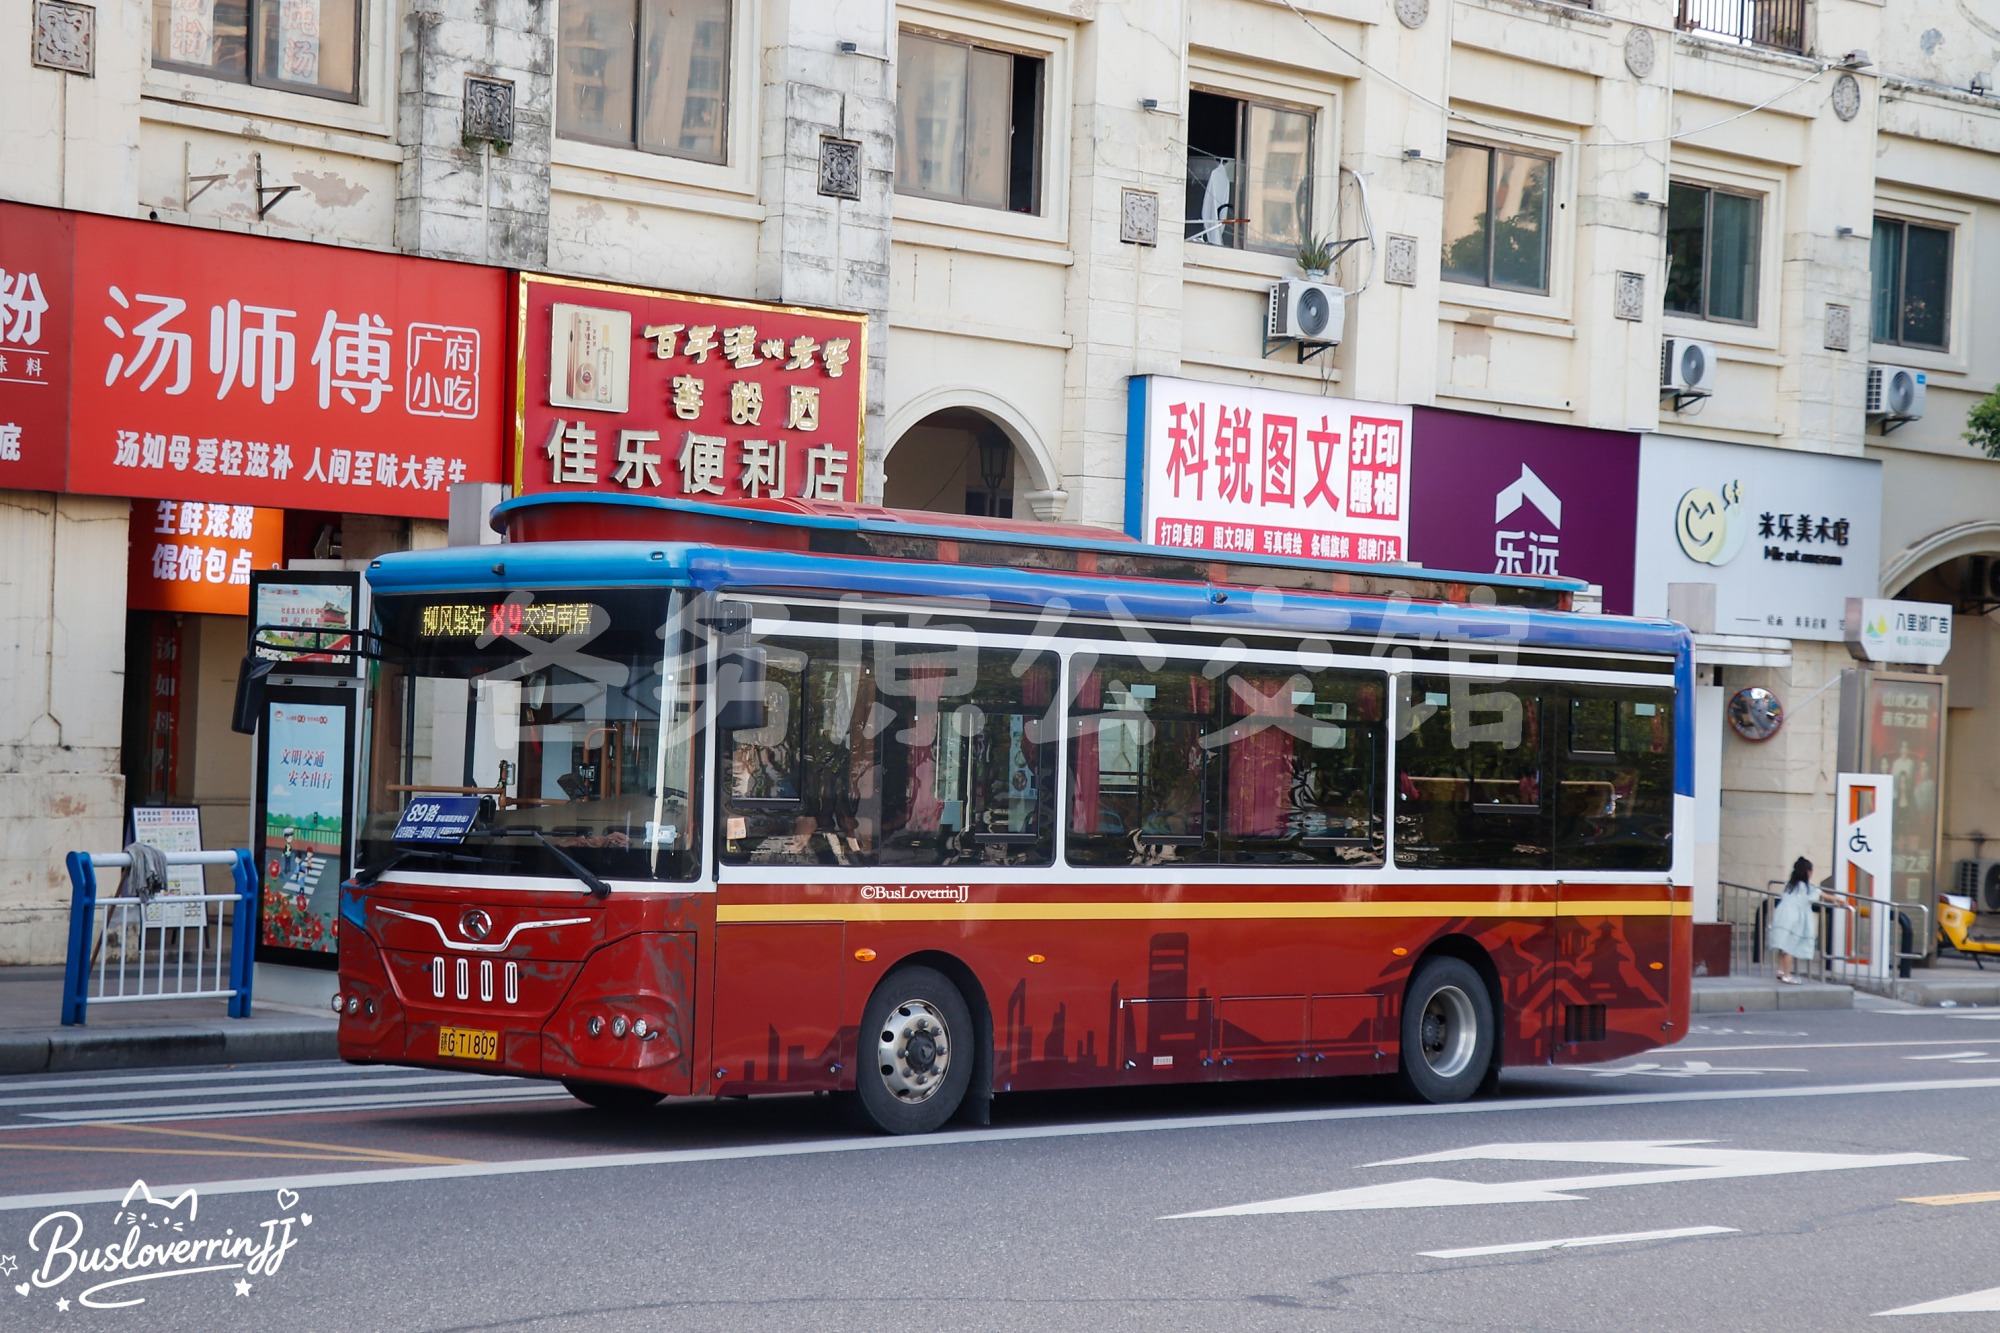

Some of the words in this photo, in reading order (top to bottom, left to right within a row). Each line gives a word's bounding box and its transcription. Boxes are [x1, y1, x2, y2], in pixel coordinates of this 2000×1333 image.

[0, 268, 49, 346] 粉
[104, 284, 394, 414] 汤师傅
[413, 331, 474, 372] 广府
[643, 323, 852, 378] 百年泸州老窖
[412, 372, 472, 410] 小吃
[113, 430, 294, 480] 汤如母爱轻滋补
[304, 447, 468, 492] 人间至味大养生
[547, 418, 849, 501] 佳乐便利店
[1165, 401, 1341, 512] 科锐图文
[1351, 421, 1400, 468] 打印
[1349, 469, 1399, 516] 照相
[154, 500, 254, 540] 生鲜滚粥
[1160, 521, 1204, 547] 打印复印
[1213, 526, 1255, 552] 图文印刷
[1263, 530, 1303, 556] 写真喷绘
[1357, 537, 1398, 562] 招牌门头
[151, 543, 253, 585] 馄饨包点
[1494, 530, 1560, 576] 乐远
[422, 604, 487, 637] 柳风驿站
[492, 603, 522, 637] 89
[280, 748, 326, 768] 文明交通
[288, 770, 333, 790] 安全出行
[407, 804, 440, 823] 89路
